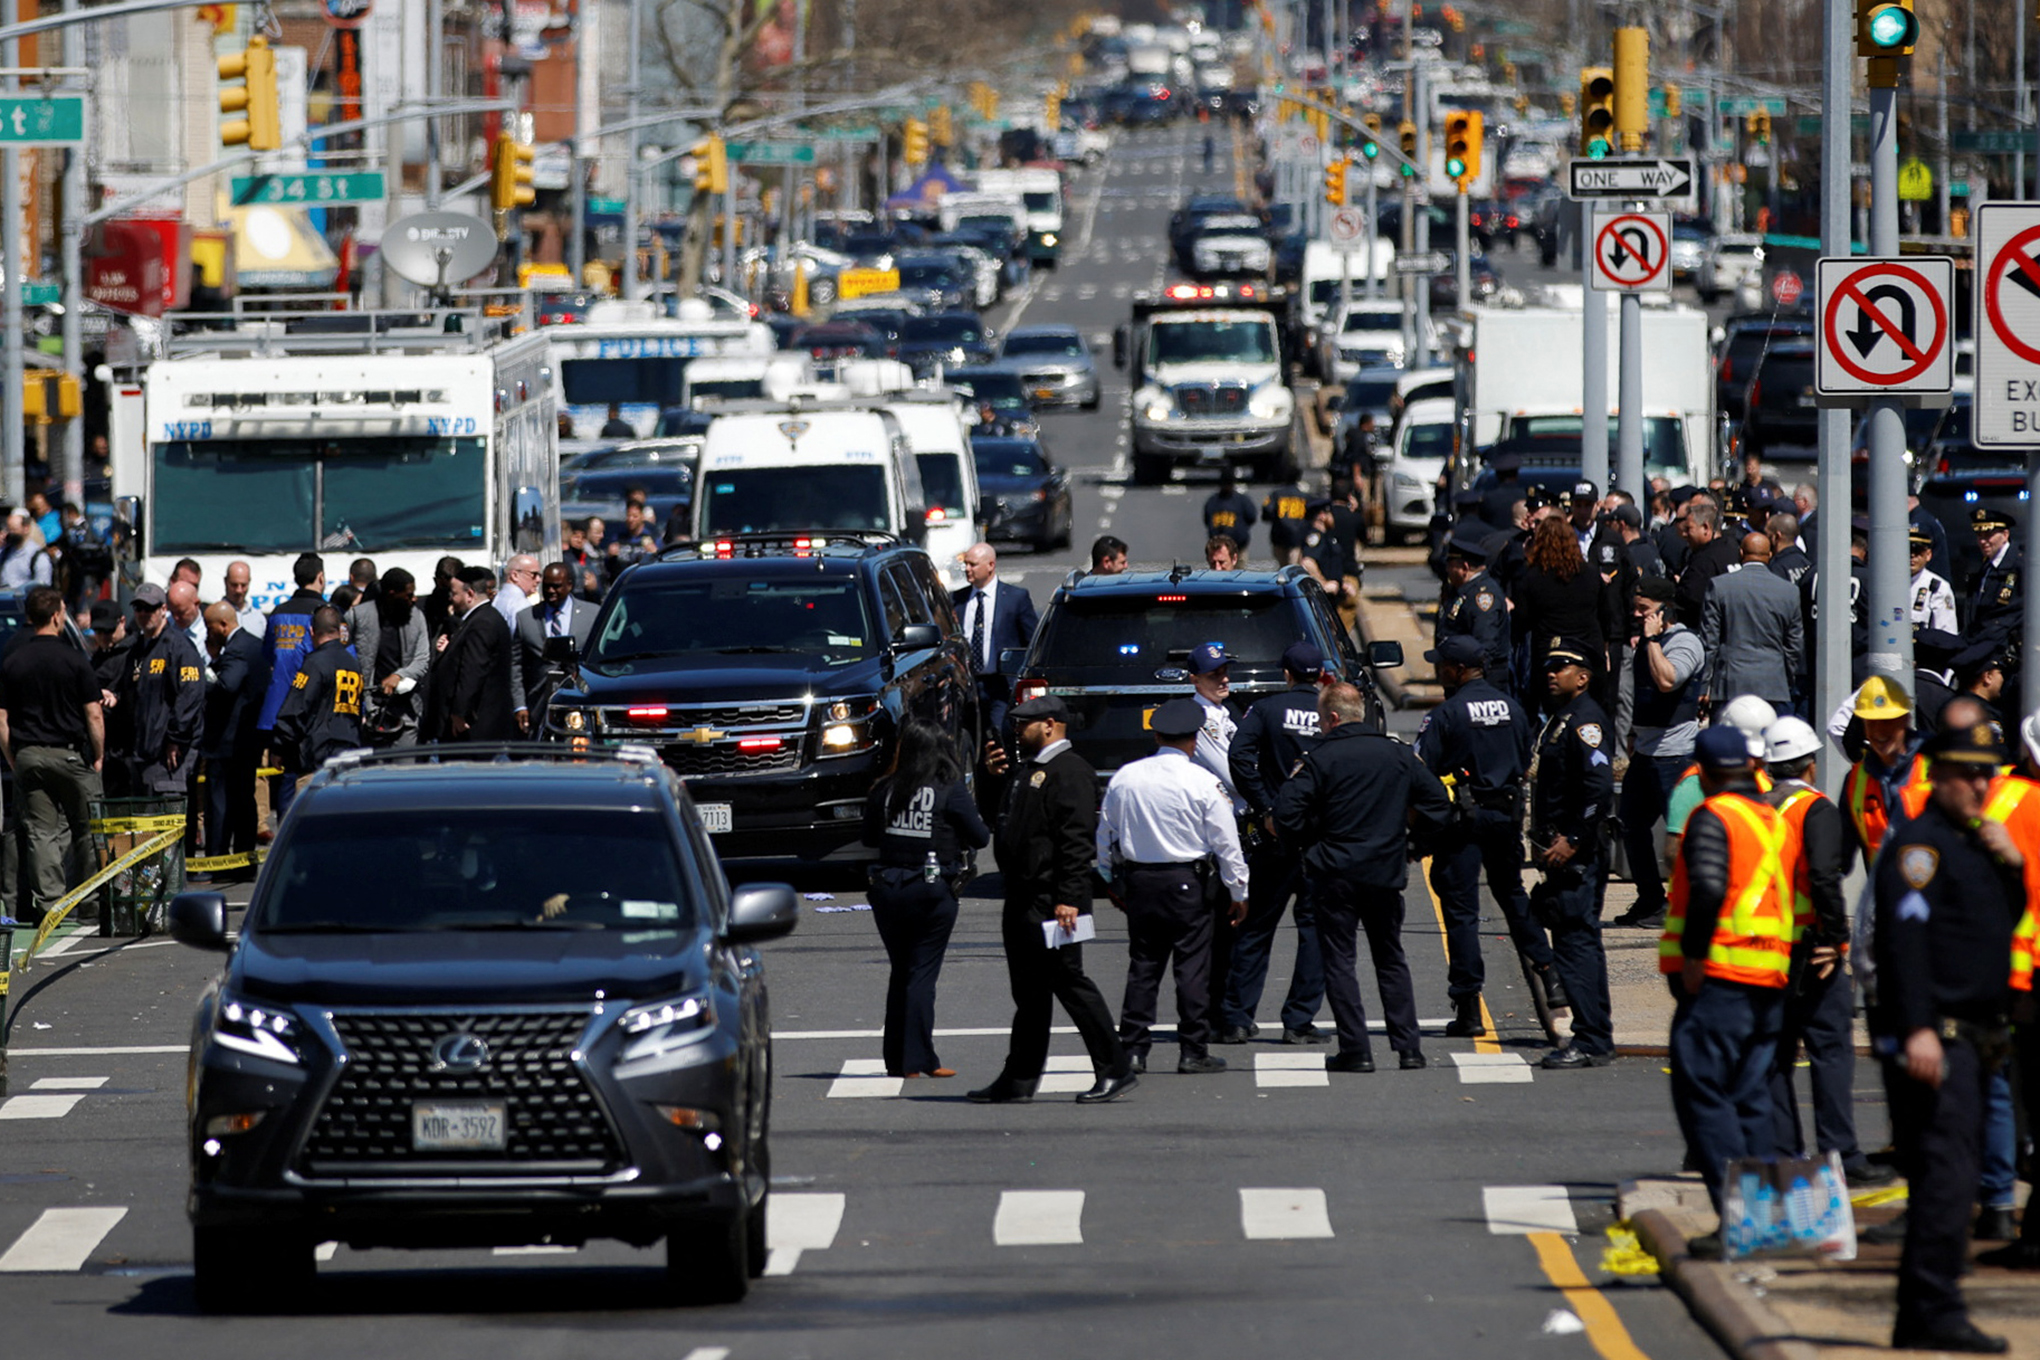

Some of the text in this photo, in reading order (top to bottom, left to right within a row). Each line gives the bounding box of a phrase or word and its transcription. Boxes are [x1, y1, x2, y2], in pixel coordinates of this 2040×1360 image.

[1580, 170, 1677, 188] ONE WAY
[268, 176, 348, 201] 34 St
[2007, 380, 2040, 401] EX
[163, 422, 213, 440] NYPD
[426, 418, 476, 435] NYPD
[180, 666, 198, 676] FBI
[1285, 708, 1320, 726] NYP
[1467, 700, 1510, 717] NYPD
